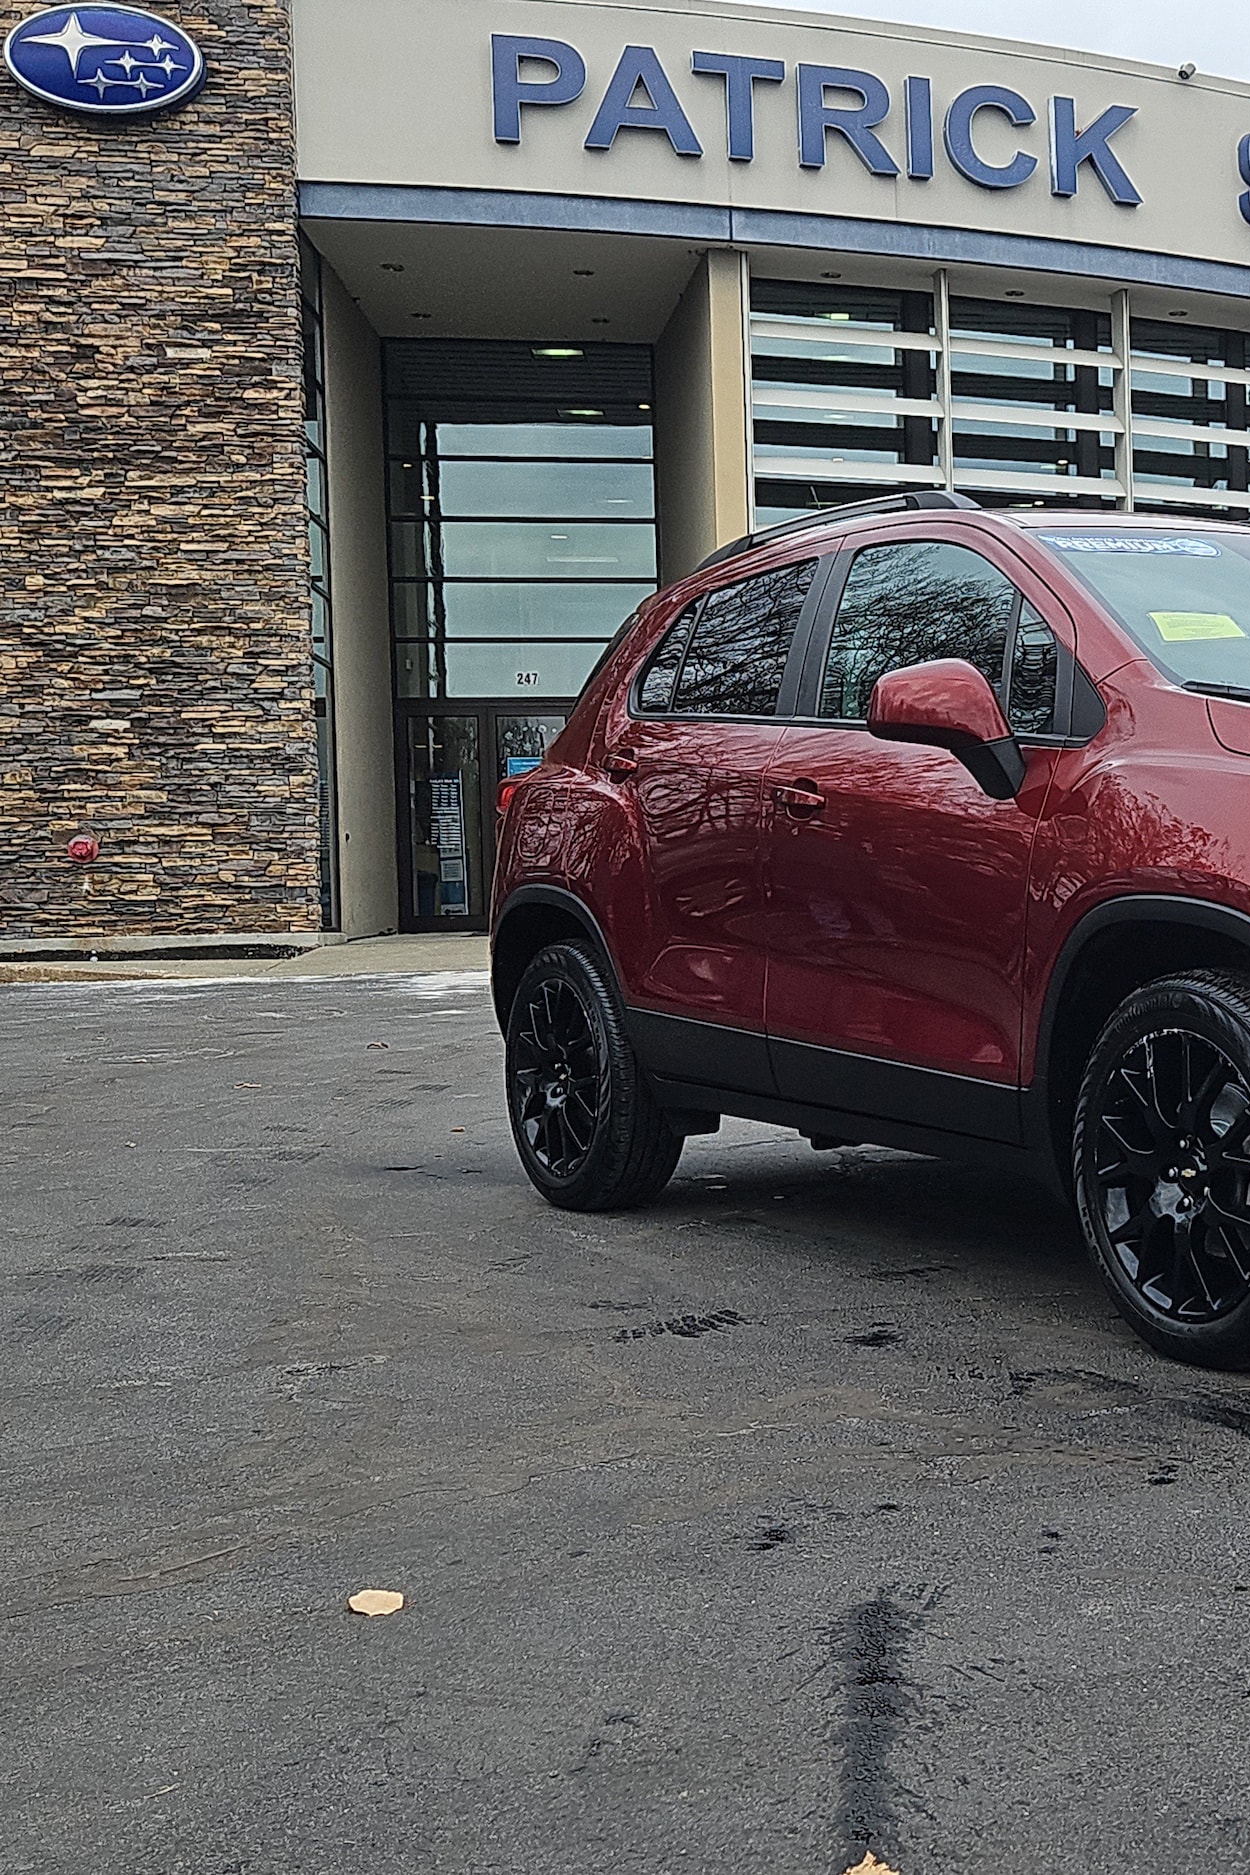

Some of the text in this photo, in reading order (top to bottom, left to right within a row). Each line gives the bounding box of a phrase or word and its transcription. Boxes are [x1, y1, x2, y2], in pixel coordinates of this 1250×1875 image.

[492, 33, 1144, 208] PATRICK
[1056, 540, 1175, 551] PREMIUM
[516, 673, 539, 685] 247
